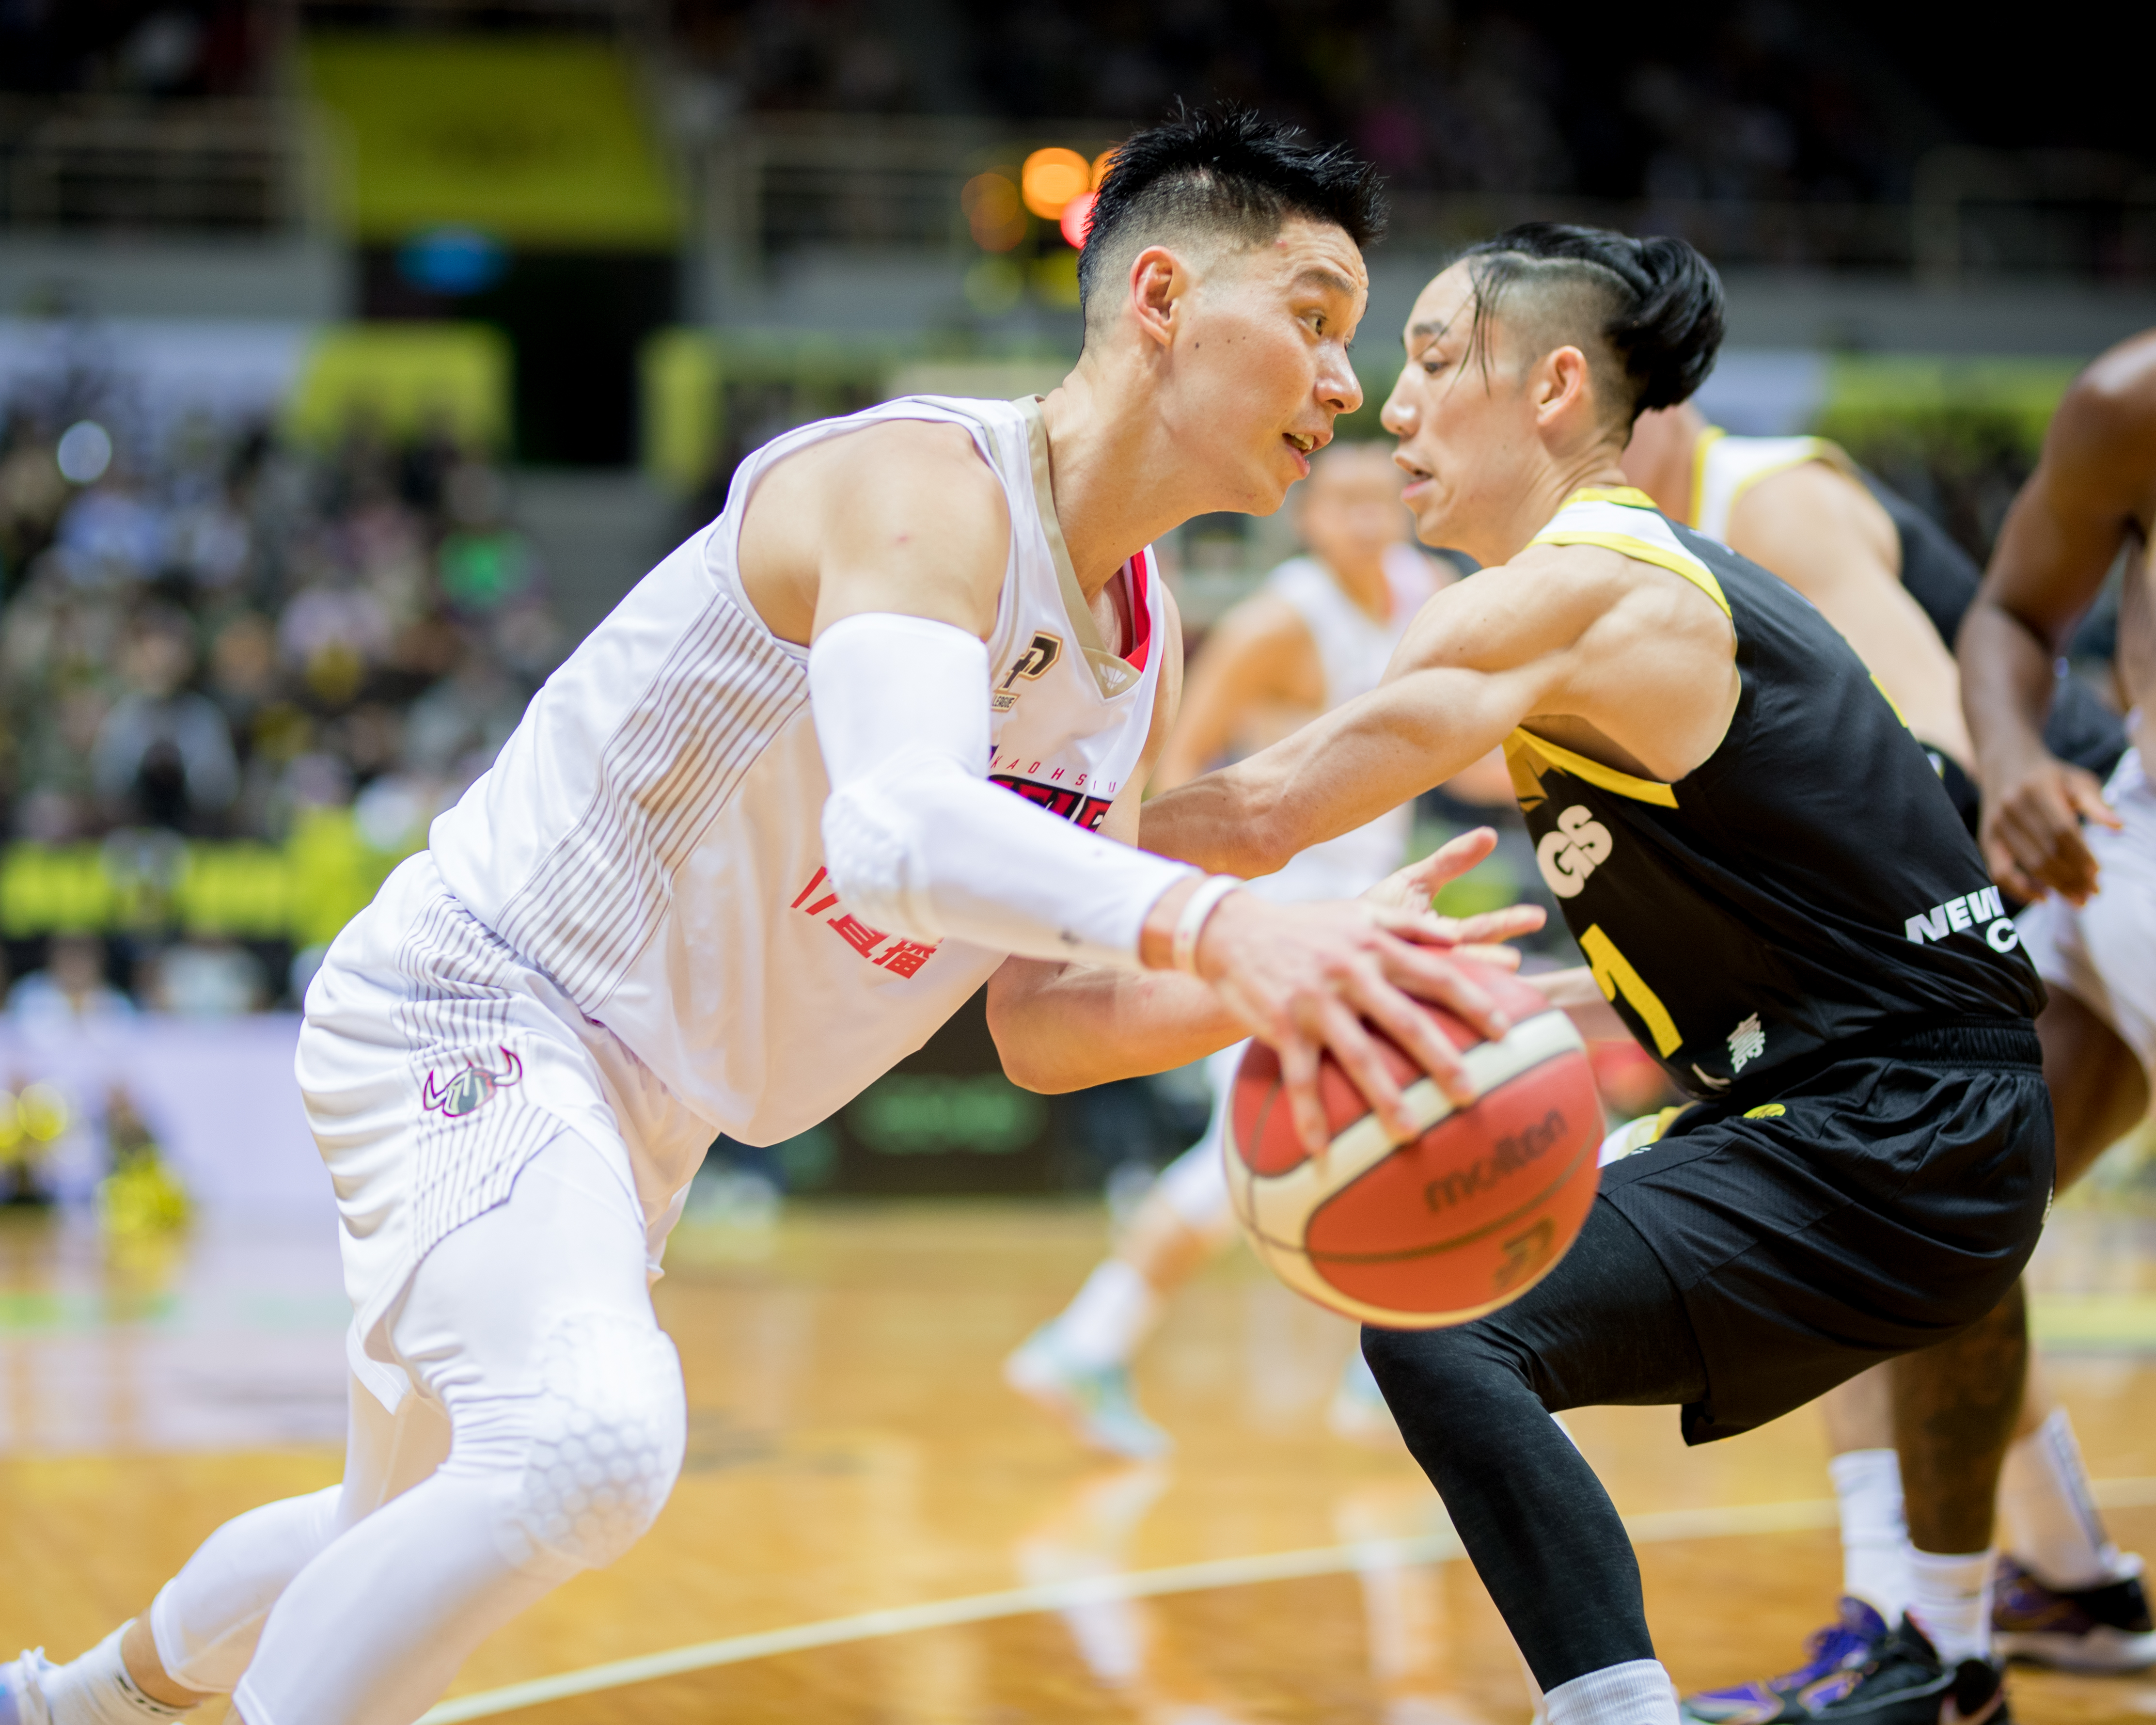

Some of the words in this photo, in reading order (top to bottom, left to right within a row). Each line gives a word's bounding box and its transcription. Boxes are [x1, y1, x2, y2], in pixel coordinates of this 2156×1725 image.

[991, 696, 1016, 709] LEAGUE
[990, 755, 1117, 793] KAOHSIU
[1904, 885, 2005, 945] NEW
[1424, 1108, 1569, 1216] molten
